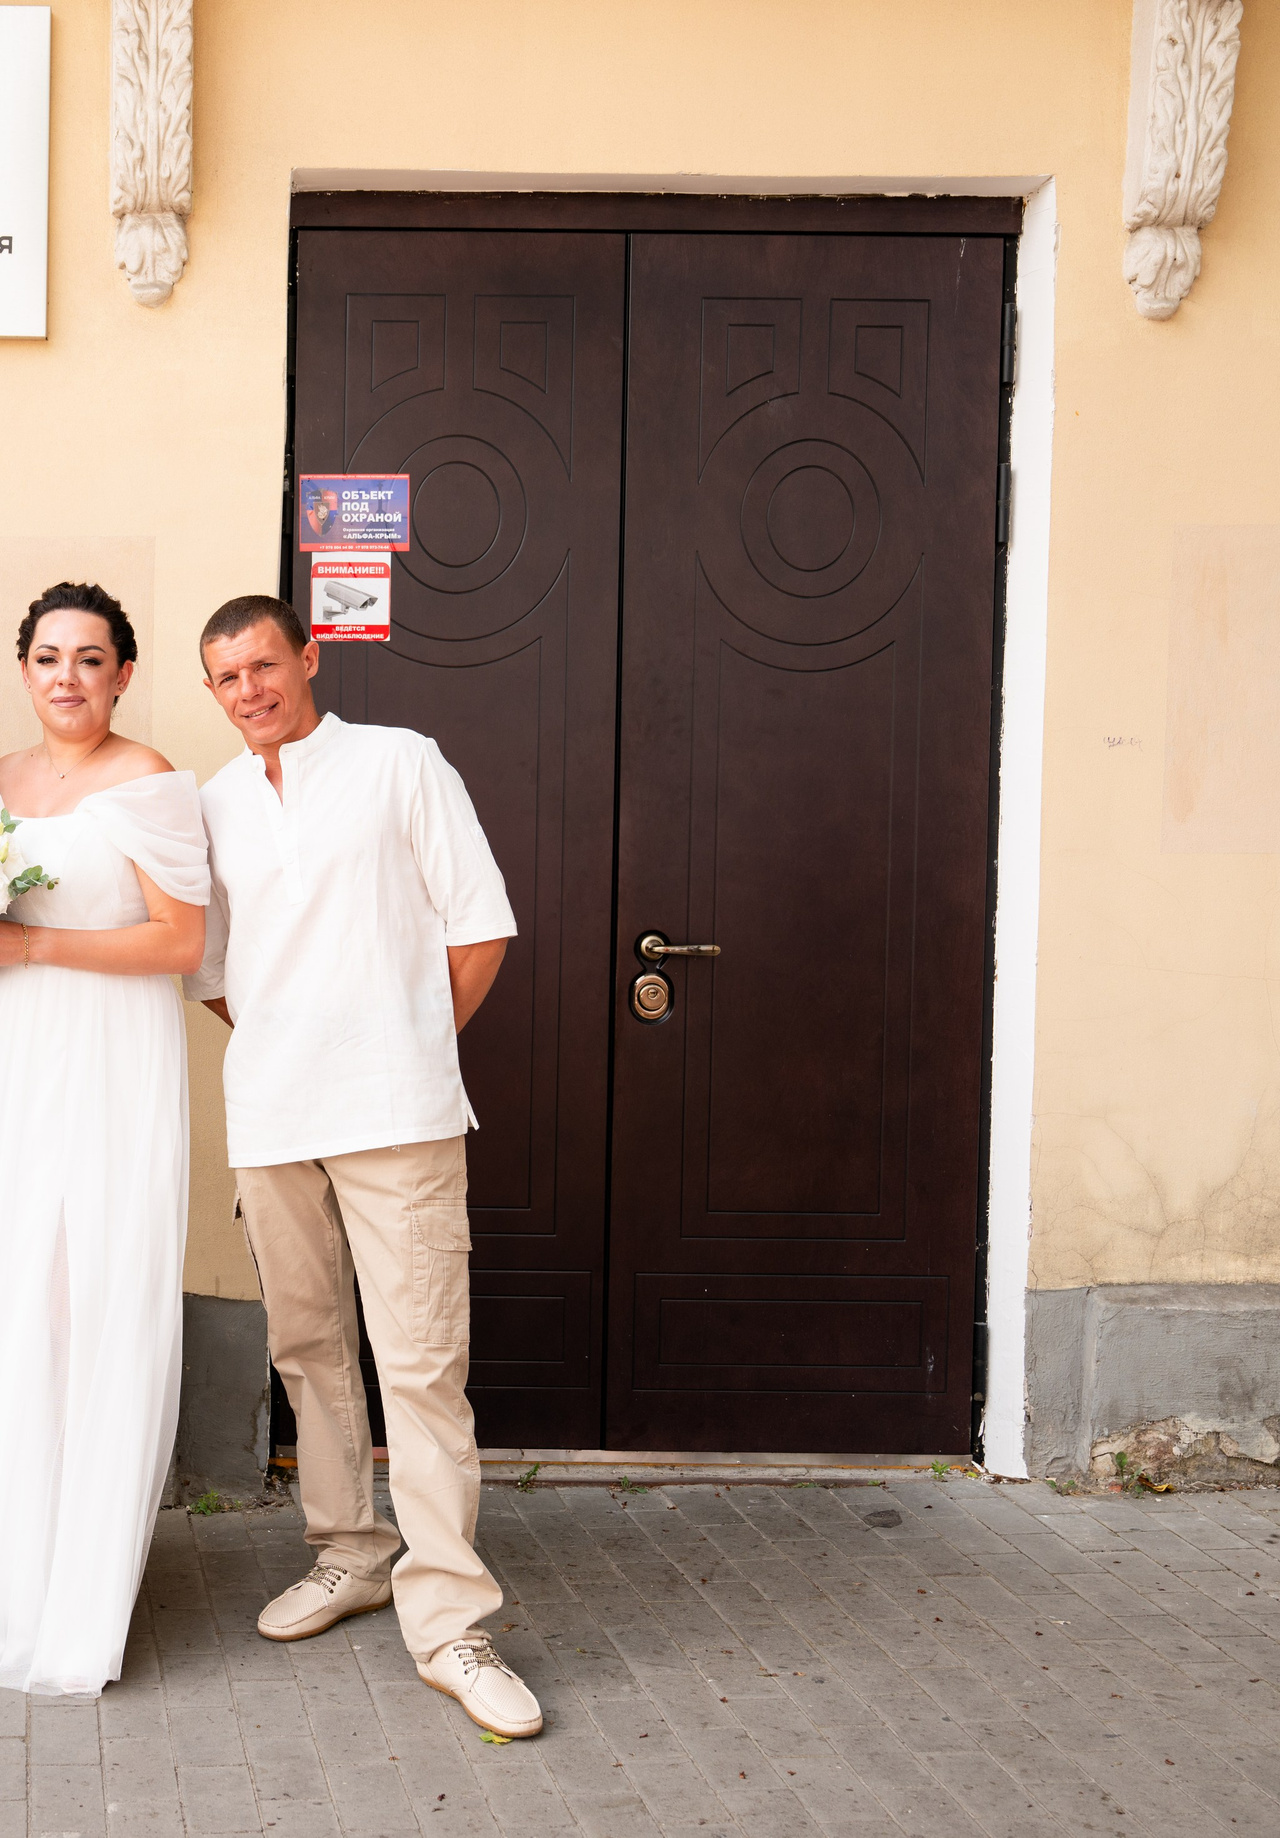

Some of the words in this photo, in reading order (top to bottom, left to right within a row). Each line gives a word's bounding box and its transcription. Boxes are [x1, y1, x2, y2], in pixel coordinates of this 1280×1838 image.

[341, 490, 394, 500] ОБЪЕКТ
[341, 501, 370, 512] ПОД
[341, 512, 402, 523] ОХРАНОЙ
[317, 566, 385, 574] ВНИМАНИЕ!!!
